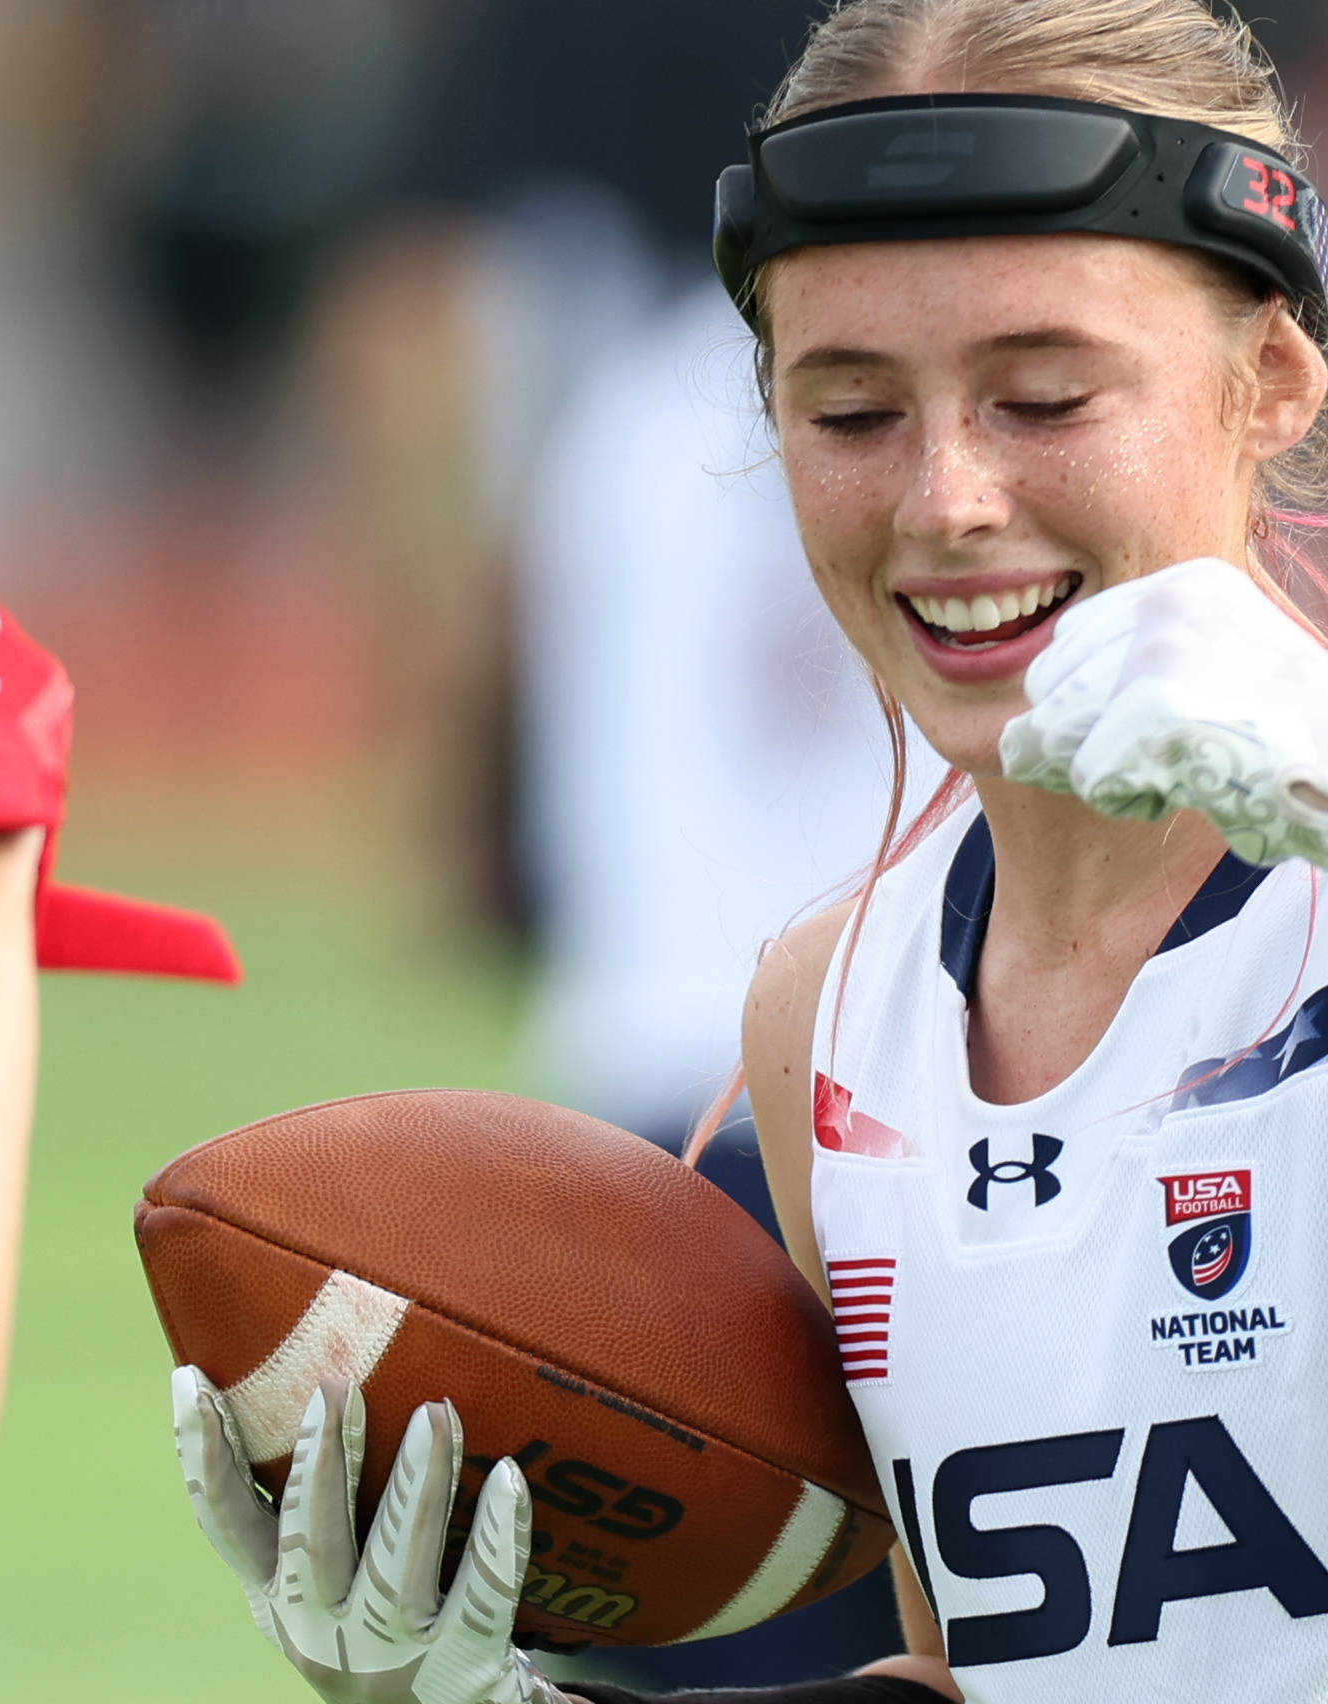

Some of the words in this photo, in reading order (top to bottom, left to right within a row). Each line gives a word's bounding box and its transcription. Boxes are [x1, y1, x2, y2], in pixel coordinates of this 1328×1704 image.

[1241, 156, 1298, 231] 32
[1171, 1174, 1243, 1201] USA
[1174, 1196, 1244, 1214] FOOTBALL
[1150, 1306, 1286, 1342] NATIONAL
[1177, 1337, 1258, 1367] TEAM
